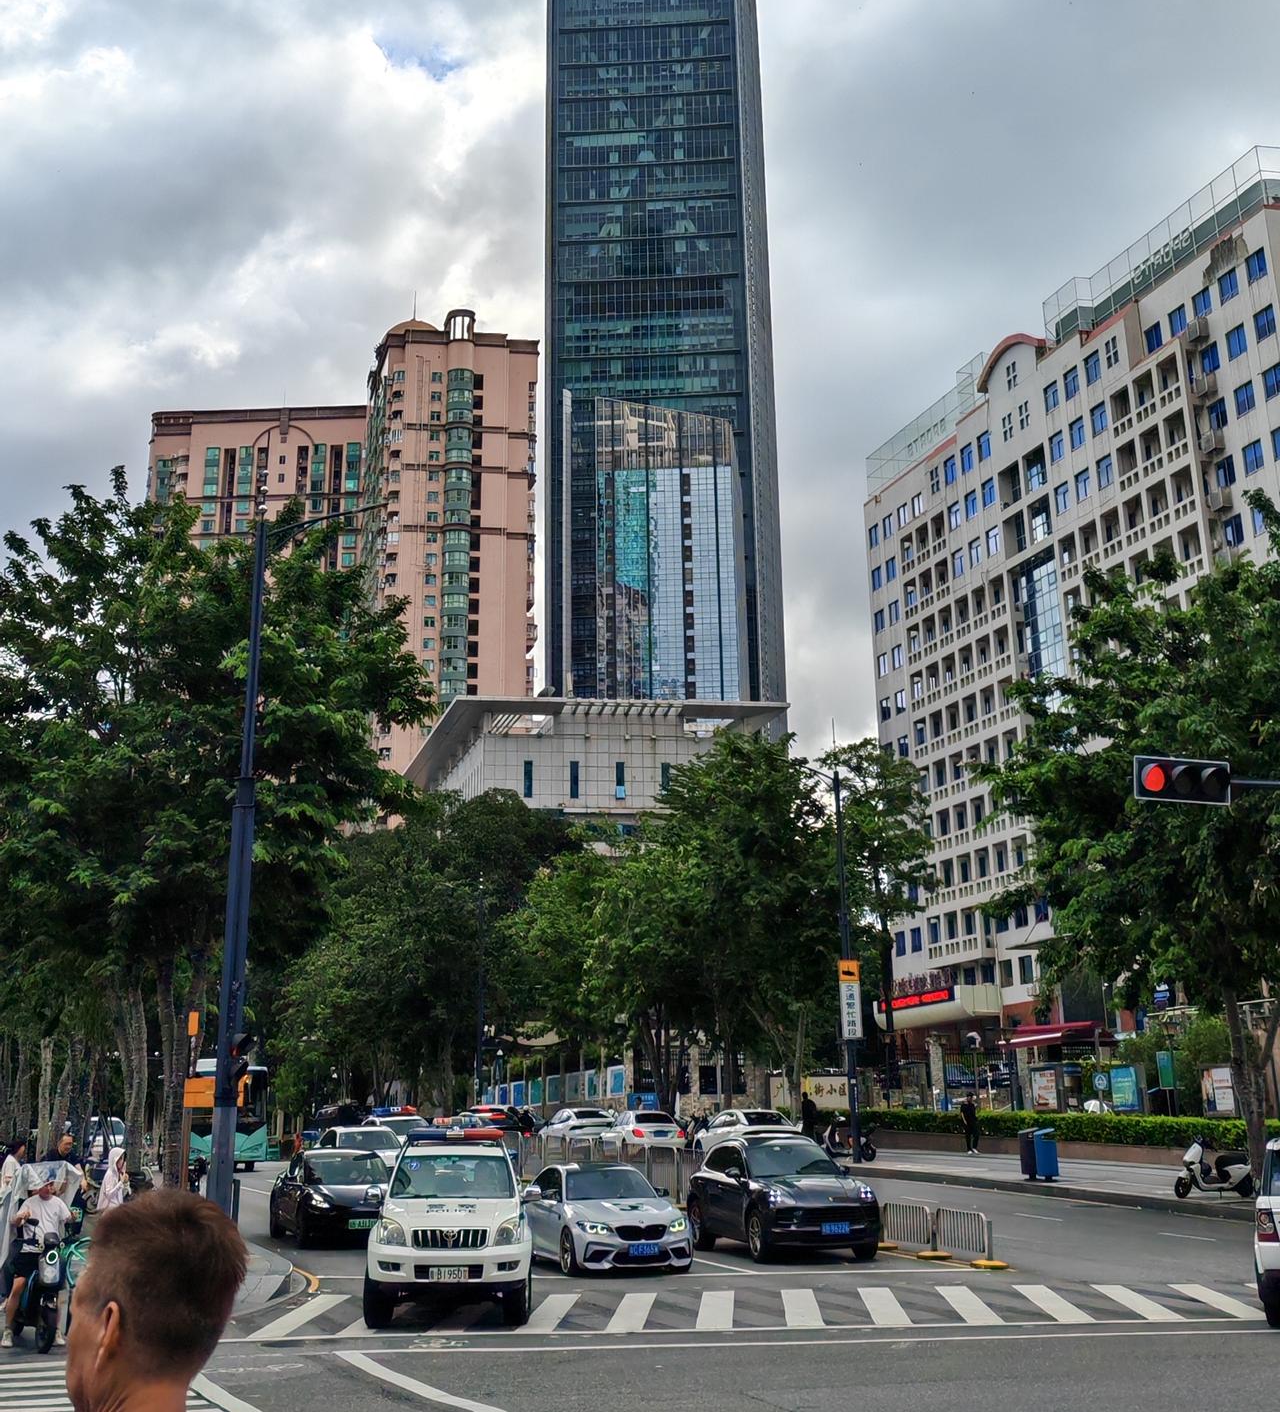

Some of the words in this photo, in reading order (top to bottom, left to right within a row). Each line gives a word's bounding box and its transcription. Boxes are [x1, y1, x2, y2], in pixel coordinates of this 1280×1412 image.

[845, 984, 857, 1037] 交通繁忙路段
